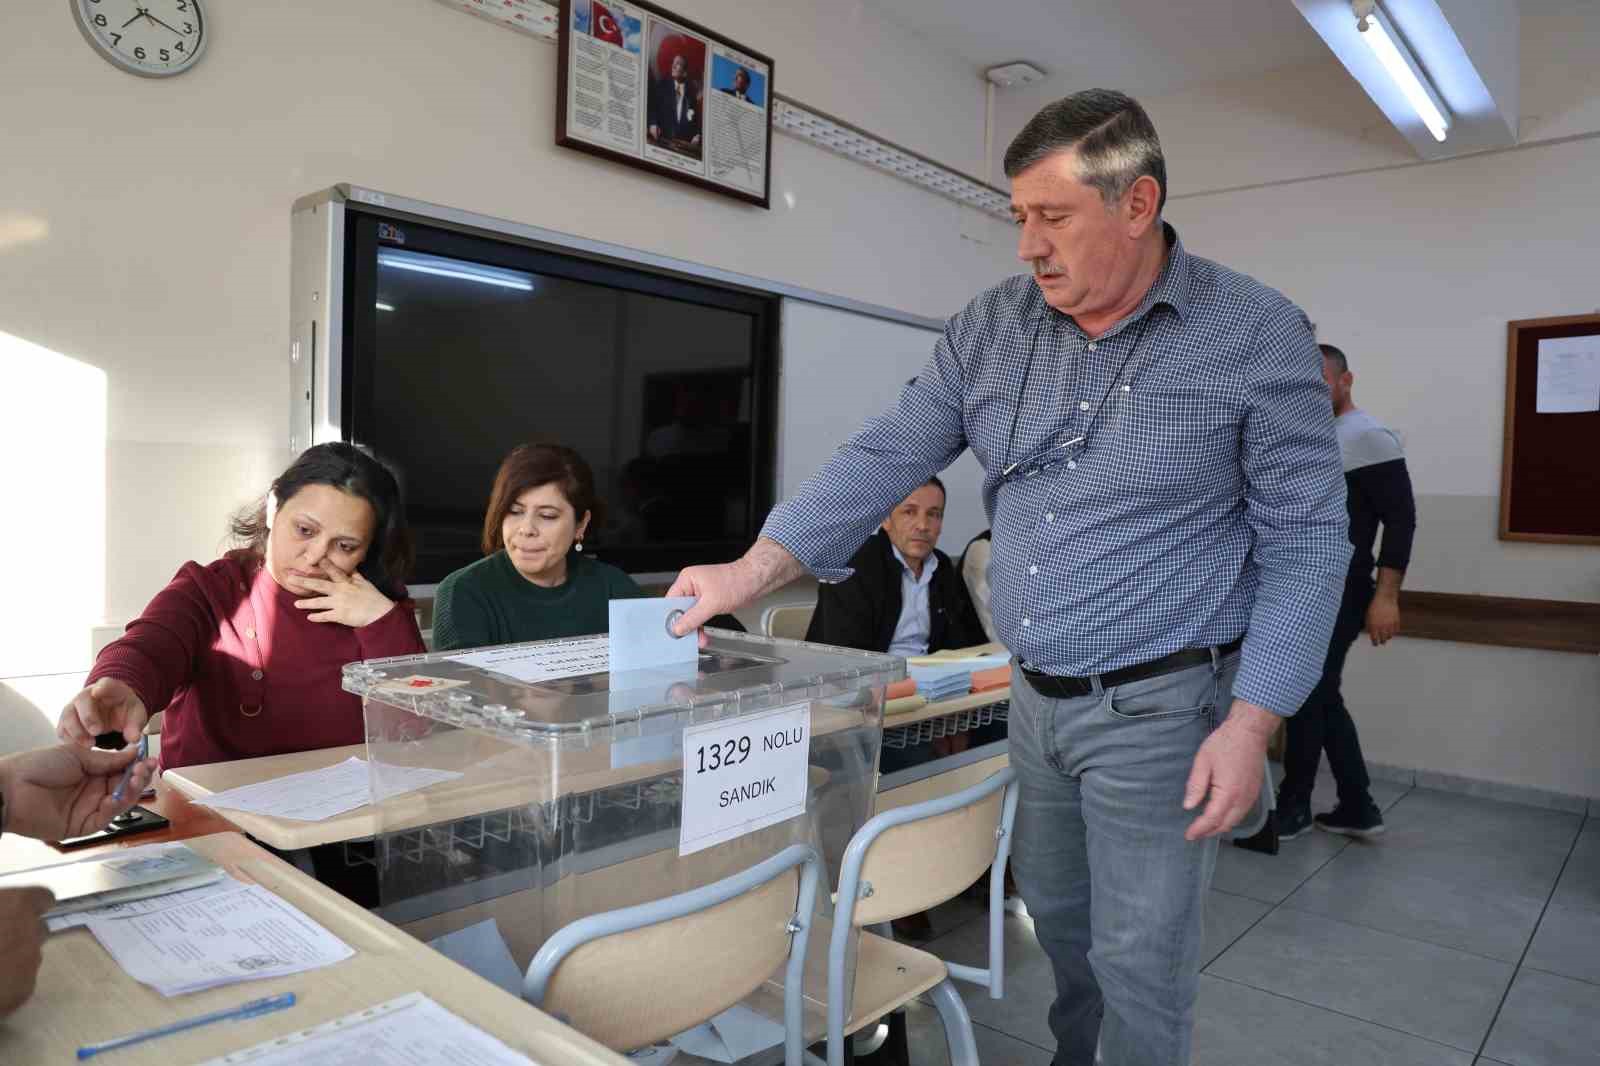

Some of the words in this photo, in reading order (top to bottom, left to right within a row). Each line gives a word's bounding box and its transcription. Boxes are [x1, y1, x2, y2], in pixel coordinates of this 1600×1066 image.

[177, 0, 187, 13] 2
[94, 13, 108, 27] 8
[183, 22, 193, 34] 3
[109, 32, 122, 46] 7
[174, 41, 184, 52] 4
[134, 47, 146, 60] 6
[159, 49, 170, 61] 5
[696, 735, 752, 775] 1329
[763, 727, 803, 752] NOLU
[719, 776, 776, 808] SANDIK
